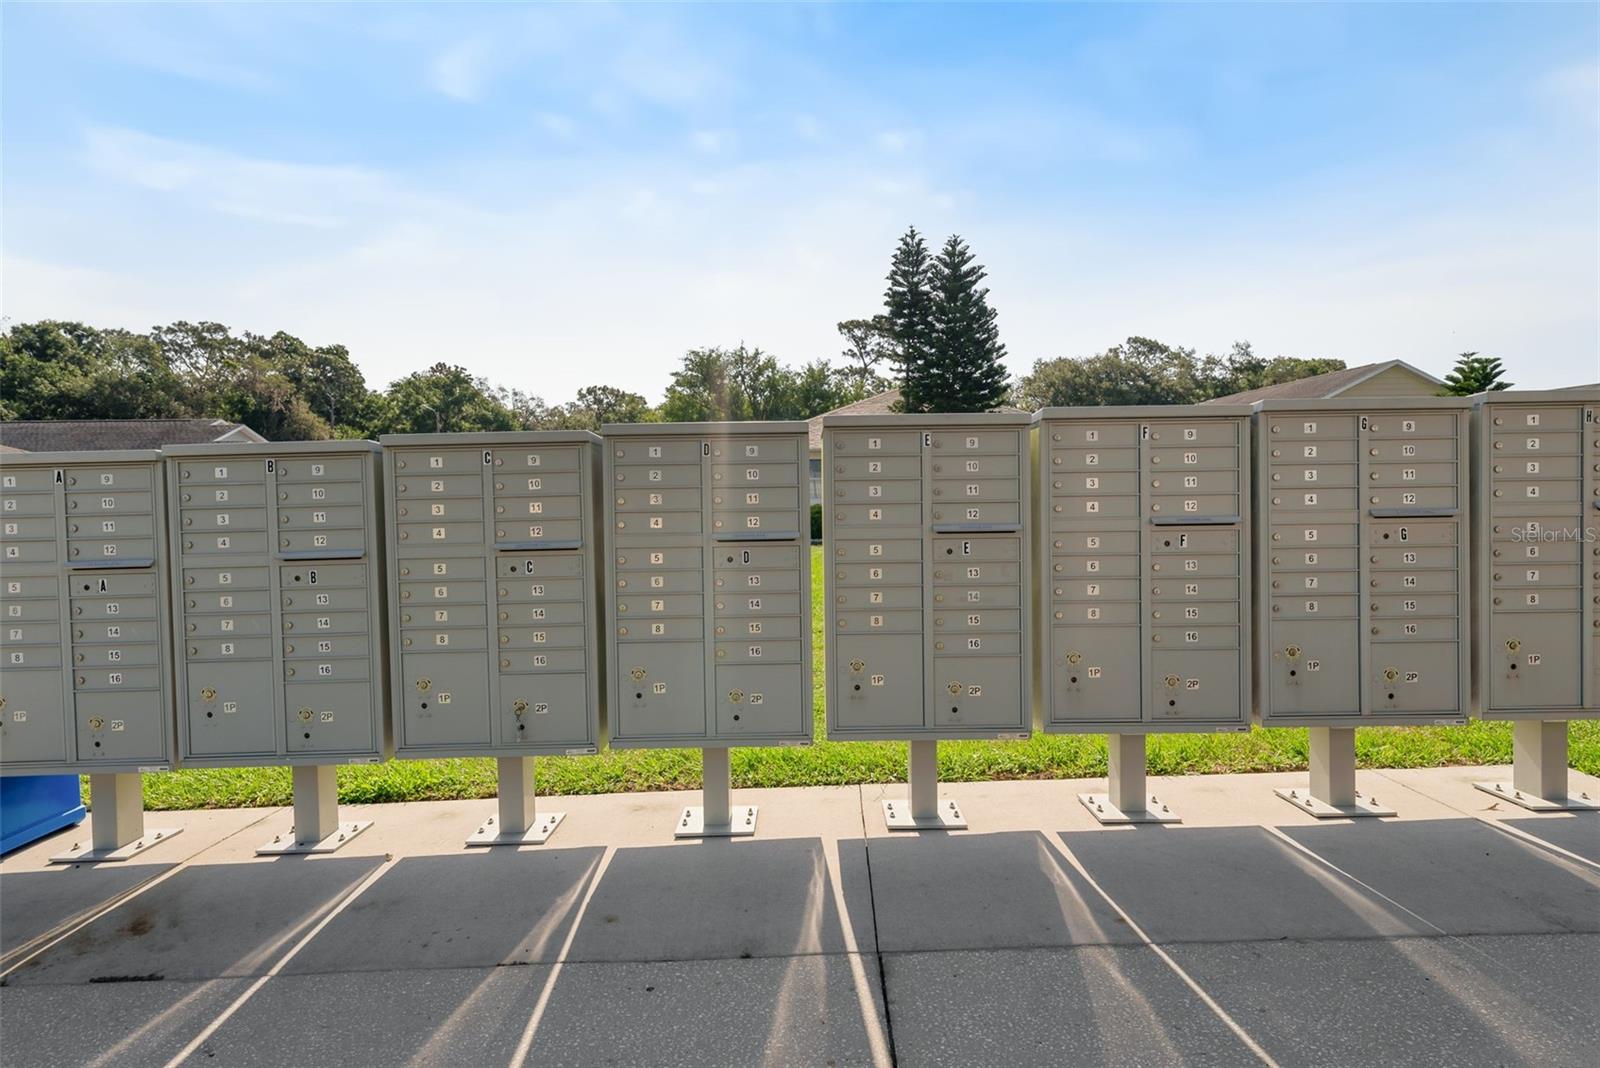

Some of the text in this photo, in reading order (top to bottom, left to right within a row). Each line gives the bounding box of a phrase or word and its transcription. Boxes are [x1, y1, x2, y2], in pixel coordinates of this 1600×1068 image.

[1586, 410, 1592, 422] H
[1361, 417, 1367, 430] G
[1406, 422, 1412, 431] 9
[1142, 426, 1148, 439] F
[1187, 430, 1194, 439] 9
[924, 433, 930, 447] E
[969, 438, 975, 447] 9
[1530, 439, 1536, 448] 2
[703, 443, 710, 456] D
[749, 447, 755, 455] 9
[1308, 447, 1314, 456] 2
[1404, 446, 1415, 455] 10
[484, 451, 491, 464] C
[530, 456, 537, 464] 9
[1089, 455, 1096, 463] 2
[1185, 454, 1196, 463] 10
[267, 460, 274, 473] B
[314, 466, 321, 474] 9
[872, 463, 878, 472] 2
[967, 462, 978, 470] 10
[1530, 463, 1536, 472] 3
[56, 470, 63, 483] A
[653, 471, 659, 480] 2
[747, 470, 758, 479] 10
[1308, 471, 1314, 480] 3
[1404, 470, 1414, 478] 11
[103, 475, 110, 483] 9
[530, 479, 540, 488] 10
[1089, 479, 1096, 487] 3
[1186, 478, 1196, 486] 11
[434, 482, 441, 490] 2
[968, 486, 978, 494] 11
[219, 491, 225, 500] 2
[314, 489, 324, 498] 10
[872, 487, 879, 496] 3
[103, 499, 114, 507] 10
[653, 495, 659, 503] 3
[1308, 495, 1314, 503] 4
[1404, 494, 1415, 503] 12
[7, 501, 14, 509] 2
[435, 505, 441, 514] 3
[531, 503, 541, 511] 11
[1089, 503, 1095, 511] 4
[1186, 502, 1197, 510] 12
[315, 513, 325, 521] 11
[968, 510, 978, 518] 12
[220, 515, 226, 524] 3
[748, 518, 759, 526] 12
[8, 524, 15, 533] 3
[531, 527, 542, 535] 12
[1530, 523, 1536, 532] 5
[436, 529, 442, 537] 4
[1308, 530, 1314, 539] 5
[1401, 528, 1407, 541] G
[315, 536, 326, 545] 12
[1090, 538, 1097, 546] 5
[1180, 534, 1186, 547] F
[10, 548, 16, 556] 4
[105, 545, 115, 554] 12
[873, 546, 879, 554] 5
[964, 541, 969, 554] E
[1529, 547, 1536, 556] 6
[654, 554, 660, 562] 5
[743, 551, 750, 564] D
[1308, 554, 1314, 563] 6
[1405, 553, 1415, 562] 13
[437, 564, 443, 573] 5
[526, 560, 533, 573] C
[1090, 562, 1096, 570] 6
[1186, 560, 1197, 569] 13
[873, 569, 879, 578] 6
[969, 568, 979, 577] 13
[1530, 571, 1536, 579] 7
[222, 574, 229, 583] 5
[310, 571, 317, 584] B
[654, 577, 660, 586] 6
[749, 576, 760, 585] 13
[1405, 577, 1415, 585] 14
[100, 579, 107, 592] A
[1309, 578, 1315, 587] 7
[11, 583, 18, 592] 5
[438, 588, 444, 596] 6
[533, 586, 544, 594] 13
[1090, 585, 1096, 594] 7
[1187, 585, 1197, 593] 14
[318, 595, 328, 604] 13
[873, 593, 879, 601] 7
[968, 592, 979, 600] 14
[1530, 595, 1536, 604] 8
[223, 598, 230, 606] 6
[655, 601, 660, 609] 7
[750, 600, 760, 608] 14
[1309, 602, 1315, 611] 8
[1405, 601, 1416, 610] 15
[108, 604, 118, 613] 13
[1187, 609, 1198, 617] 15
[439, 611, 444, 620] 7
[534, 609, 544, 618] 14
[1090, 609, 1097, 618] 8
[319, 619, 329, 627] 14
[873, 617, 880, 625] 8
[969, 616, 980, 624] 15
[224, 621, 230, 629] 7
[655, 624, 661, 633] 8
[750, 623, 761, 632] 15
[1406, 625, 1416, 633] 16
[13, 630, 19, 638] 7
[109, 628, 119, 636] 14
[1187, 632, 1198, 641] 16
[439, 635, 446, 644] 8
[535, 633, 545, 641] 15
[320, 642, 330, 651] 15
[969, 639, 980, 648] 16
[224, 645, 231, 653] 8
[750, 647, 761, 655] 16
[14, 654, 21, 663] 8
[110, 651, 120, 660] 15
[1529, 655, 1540, 663] 1P
[535, 656, 546, 665] 16
[320, 666, 331, 674] 16
[1308, 661, 1319, 670] 1P
[1089, 668, 1101, 677] 1P
[1406, 673, 1418, 681] 2P
[111, 674, 121, 683] 16
[872, 676, 884, 684] 1P
[654, 684, 666, 692] 1P
[1187, 680, 1199, 689] 2P
[969, 687, 981, 695] 2P
[439, 694, 450, 702] 1P
[751, 695, 762, 703] 2P
[225, 703, 236, 711] 1P
[535, 704, 547, 712] 2P
[15, 712, 26, 720] 1P
[321, 712, 333, 721] 2P
[111, 721, 123, 730] 2P
